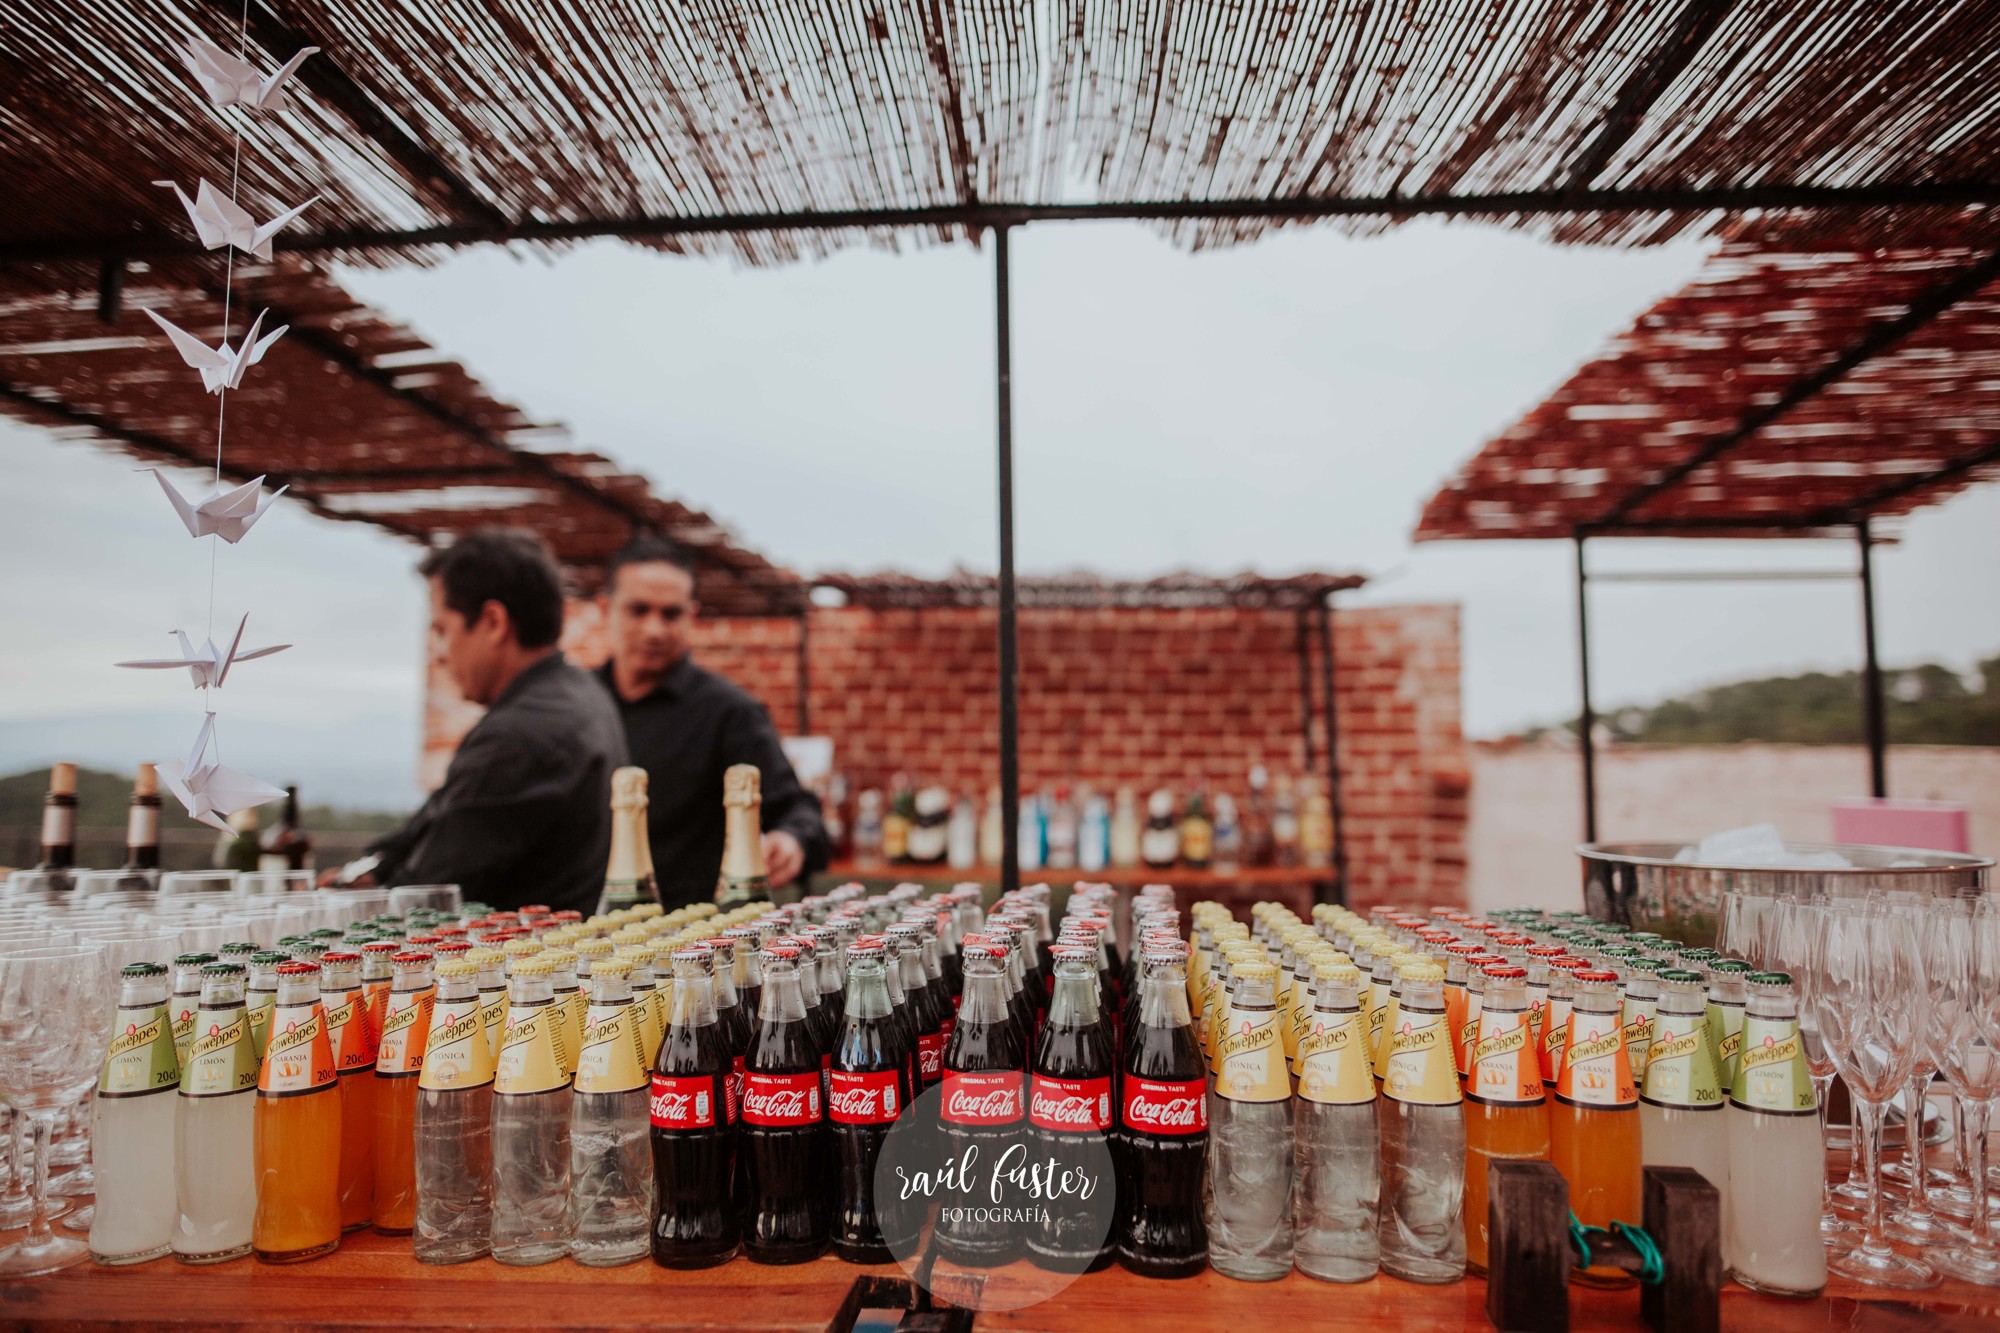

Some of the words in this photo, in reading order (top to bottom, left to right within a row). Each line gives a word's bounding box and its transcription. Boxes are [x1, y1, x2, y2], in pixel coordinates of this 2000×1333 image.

[109, 1024, 159, 1057] Schweppes
[191, 1024, 241, 1057] Schweppes
[269, 1023, 317, 1056] Schweppes
[428, 1018, 477, 1050] Schweppes
[1223, 1028, 1273, 1056] Schweppes
[1475, 1033, 1523, 1057] Schweppes
[1569, 1036, 1619, 1061] Schweppes
[1648, 1037, 1696, 1059] Schweppes
[116, 1055, 143, 1064] LIMÓN
[200, 1056, 226, 1065] LIMÓN
[275, 1054, 307, 1063] NARANJA
[345, 1052, 365, 1066] 20cl
[1744, 1042, 1796, 1067] Schweppes
[156, 1069, 176, 1084] 20cl
[239, 1071, 257, 1085] 20cl
[317, 1067, 334, 1082] 20cl
[847, 1075, 864, 1083] TASTE
[960, 1077, 986, 1085] ORIGINAL
[1063, 1083, 1081, 1091] TASTE
[1141, 1083, 1167, 1092] ORIGINAL
[1523, 1084, 1541, 1097] 20cl
[1696, 1088, 1716, 1101] 20cl
[744, 1088, 806, 1117] Coca-Cola
[949, 1088, 1015, 1117] Coca-Cola
[1031, 1091, 1096, 1124] Coca-Cola
[1129, 1095, 1198, 1126] Coca-Cola
